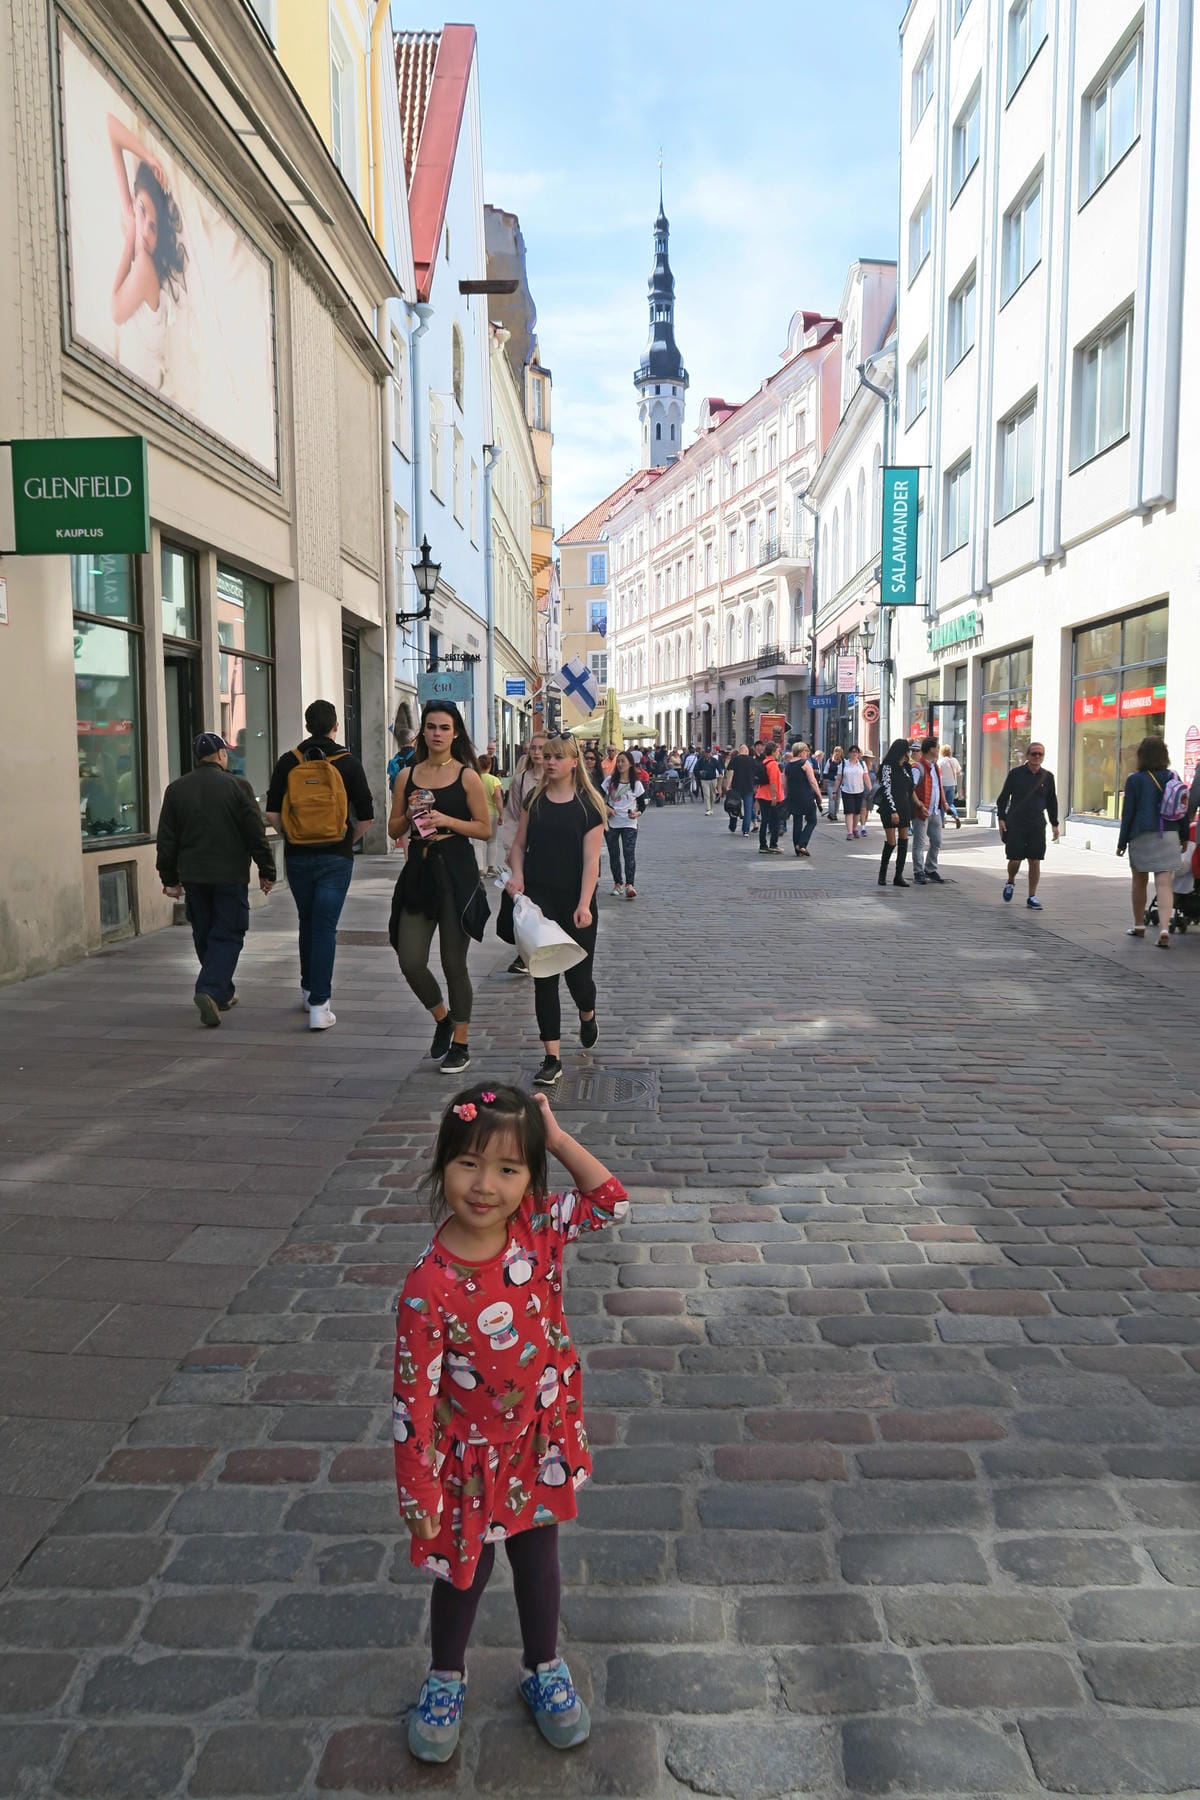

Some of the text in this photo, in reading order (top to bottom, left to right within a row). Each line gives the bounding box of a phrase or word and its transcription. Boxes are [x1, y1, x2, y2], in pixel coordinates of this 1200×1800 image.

[24, 475, 132, 500] GLENFIELD
[55, 528, 104, 538] KAUPLUS
[891, 480, 909, 593] SALAMANDER
